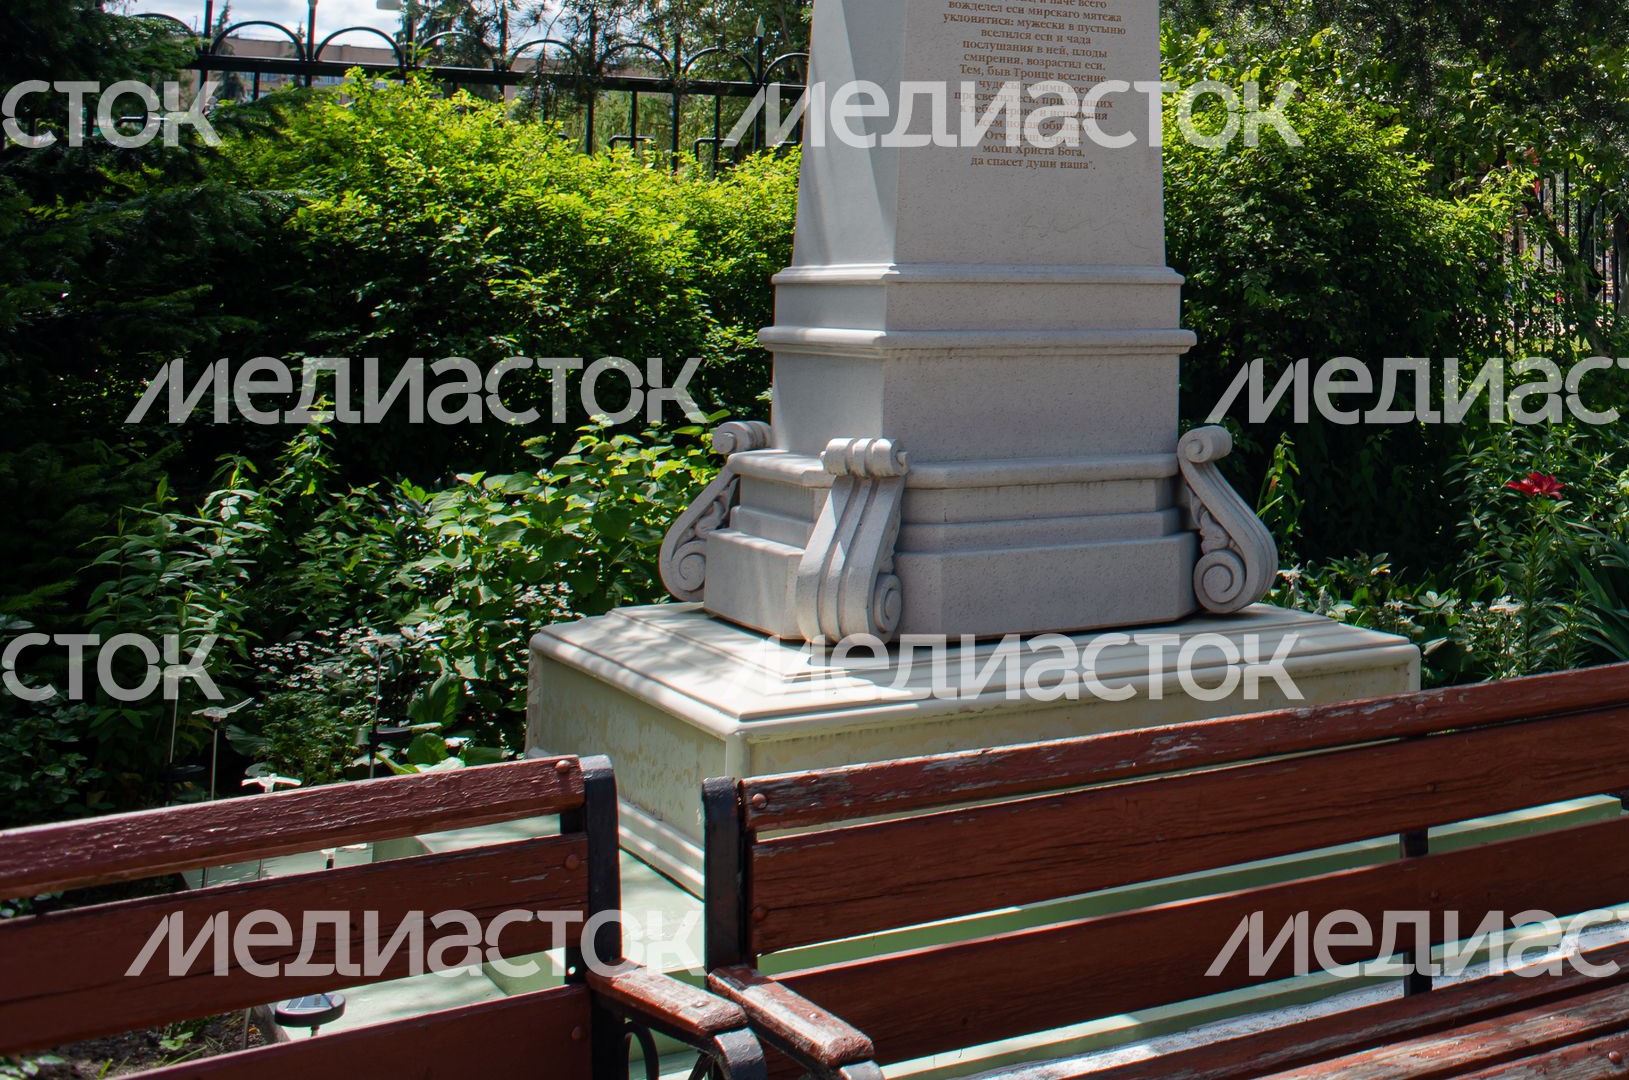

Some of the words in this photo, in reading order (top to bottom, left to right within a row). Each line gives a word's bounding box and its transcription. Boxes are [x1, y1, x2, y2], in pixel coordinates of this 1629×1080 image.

[949, 1, 1002, 12] вожделел
[1006, 6, 1024, 14] еси
[1028, 7, 1079, 19] мирскаго
[1083, 13, 1121, 21] мятежа
[1078, 0, 1107, 9] всего
[1017, 19, 1065, 30] мужески
[1077, 24, 1126, 35] пустыню
[981, 28, 1031, 40] вселился
[1034, 33, 1052, 41] еси
[1067, 36, 1091, 45] чада
[963, 40, 1033, 52] послушания
[1072, 49, 1107, 58] плоды
[1027, 58, 1081, 69] возрастил
[988, 66, 1010, 75] быв
[1014, 68, 1053, 80] Троице
[983, 144, 1013, 153] моли
[1016, 145, 1054, 156] Христа
[971, 157, 984, 166] да
[987, 158, 1022, 166] спасет
[1027, 160, 1056, 169] души
